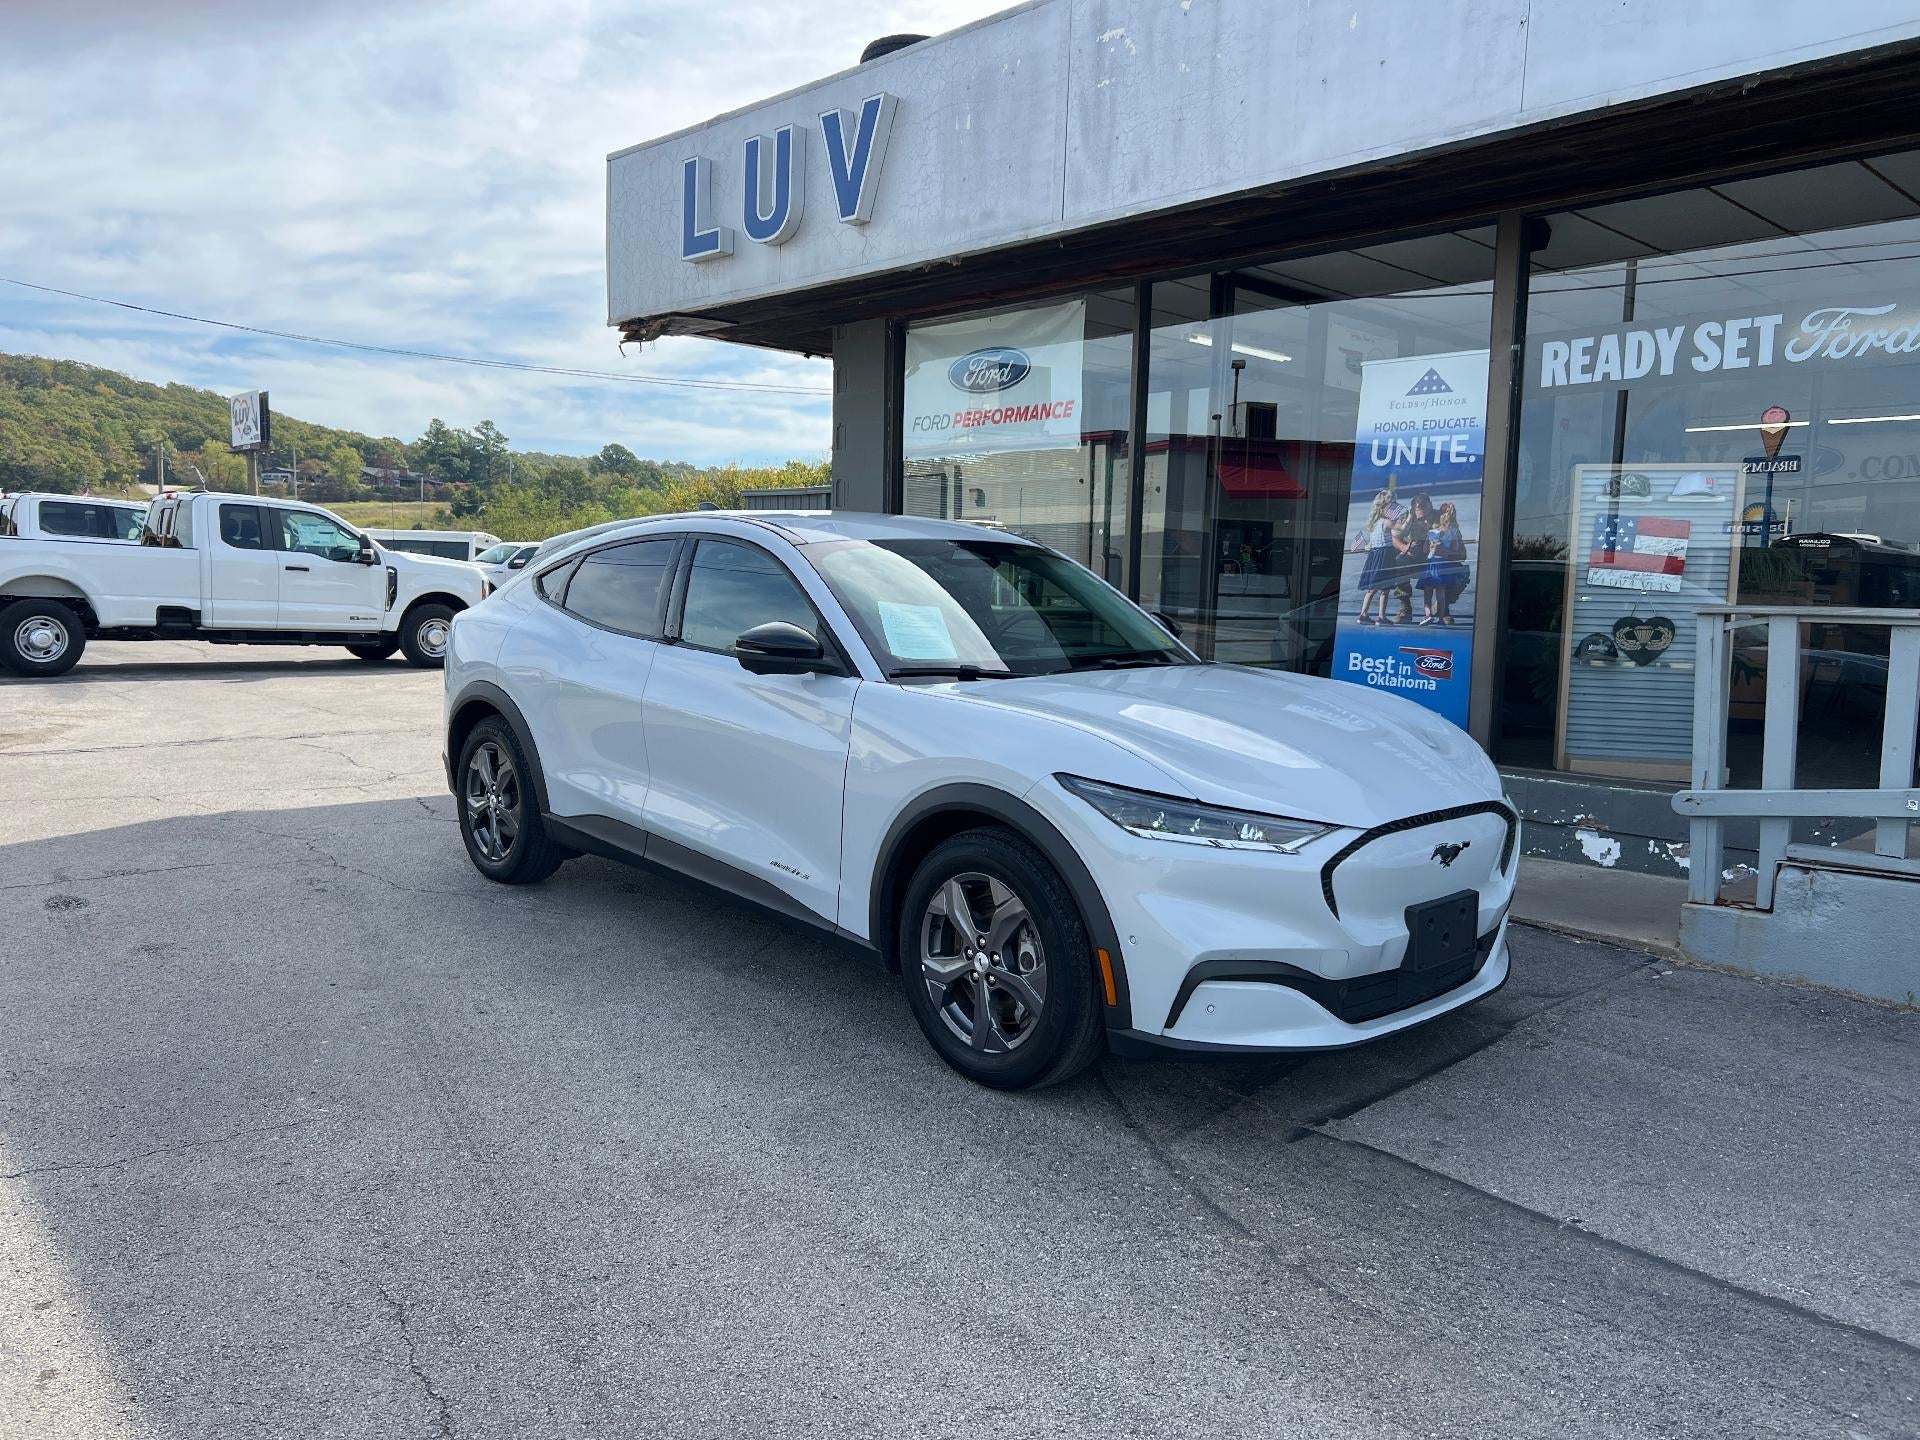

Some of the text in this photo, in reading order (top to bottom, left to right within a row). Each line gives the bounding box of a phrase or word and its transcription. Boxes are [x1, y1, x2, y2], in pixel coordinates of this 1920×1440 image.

[681, 91, 898, 264] LUV
[1540, 303, 1920, 387] READY SET Ford
[963, 354, 1014, 386] Ford
[912, 400, 1075, 432] FORD PERFORMANCE
[1389, 397, 1468, 410] FOLDS of HONOR
[1374, 416, 1479, 433] HONOR. EDUCATE.
[1371, 434, 1476, 467] UNITE.
[1348, 652, 1411, 676] Best in
[1420, 657, 1446, 670] Ford
[1367, 673, 1436, 691] Oklahoma
